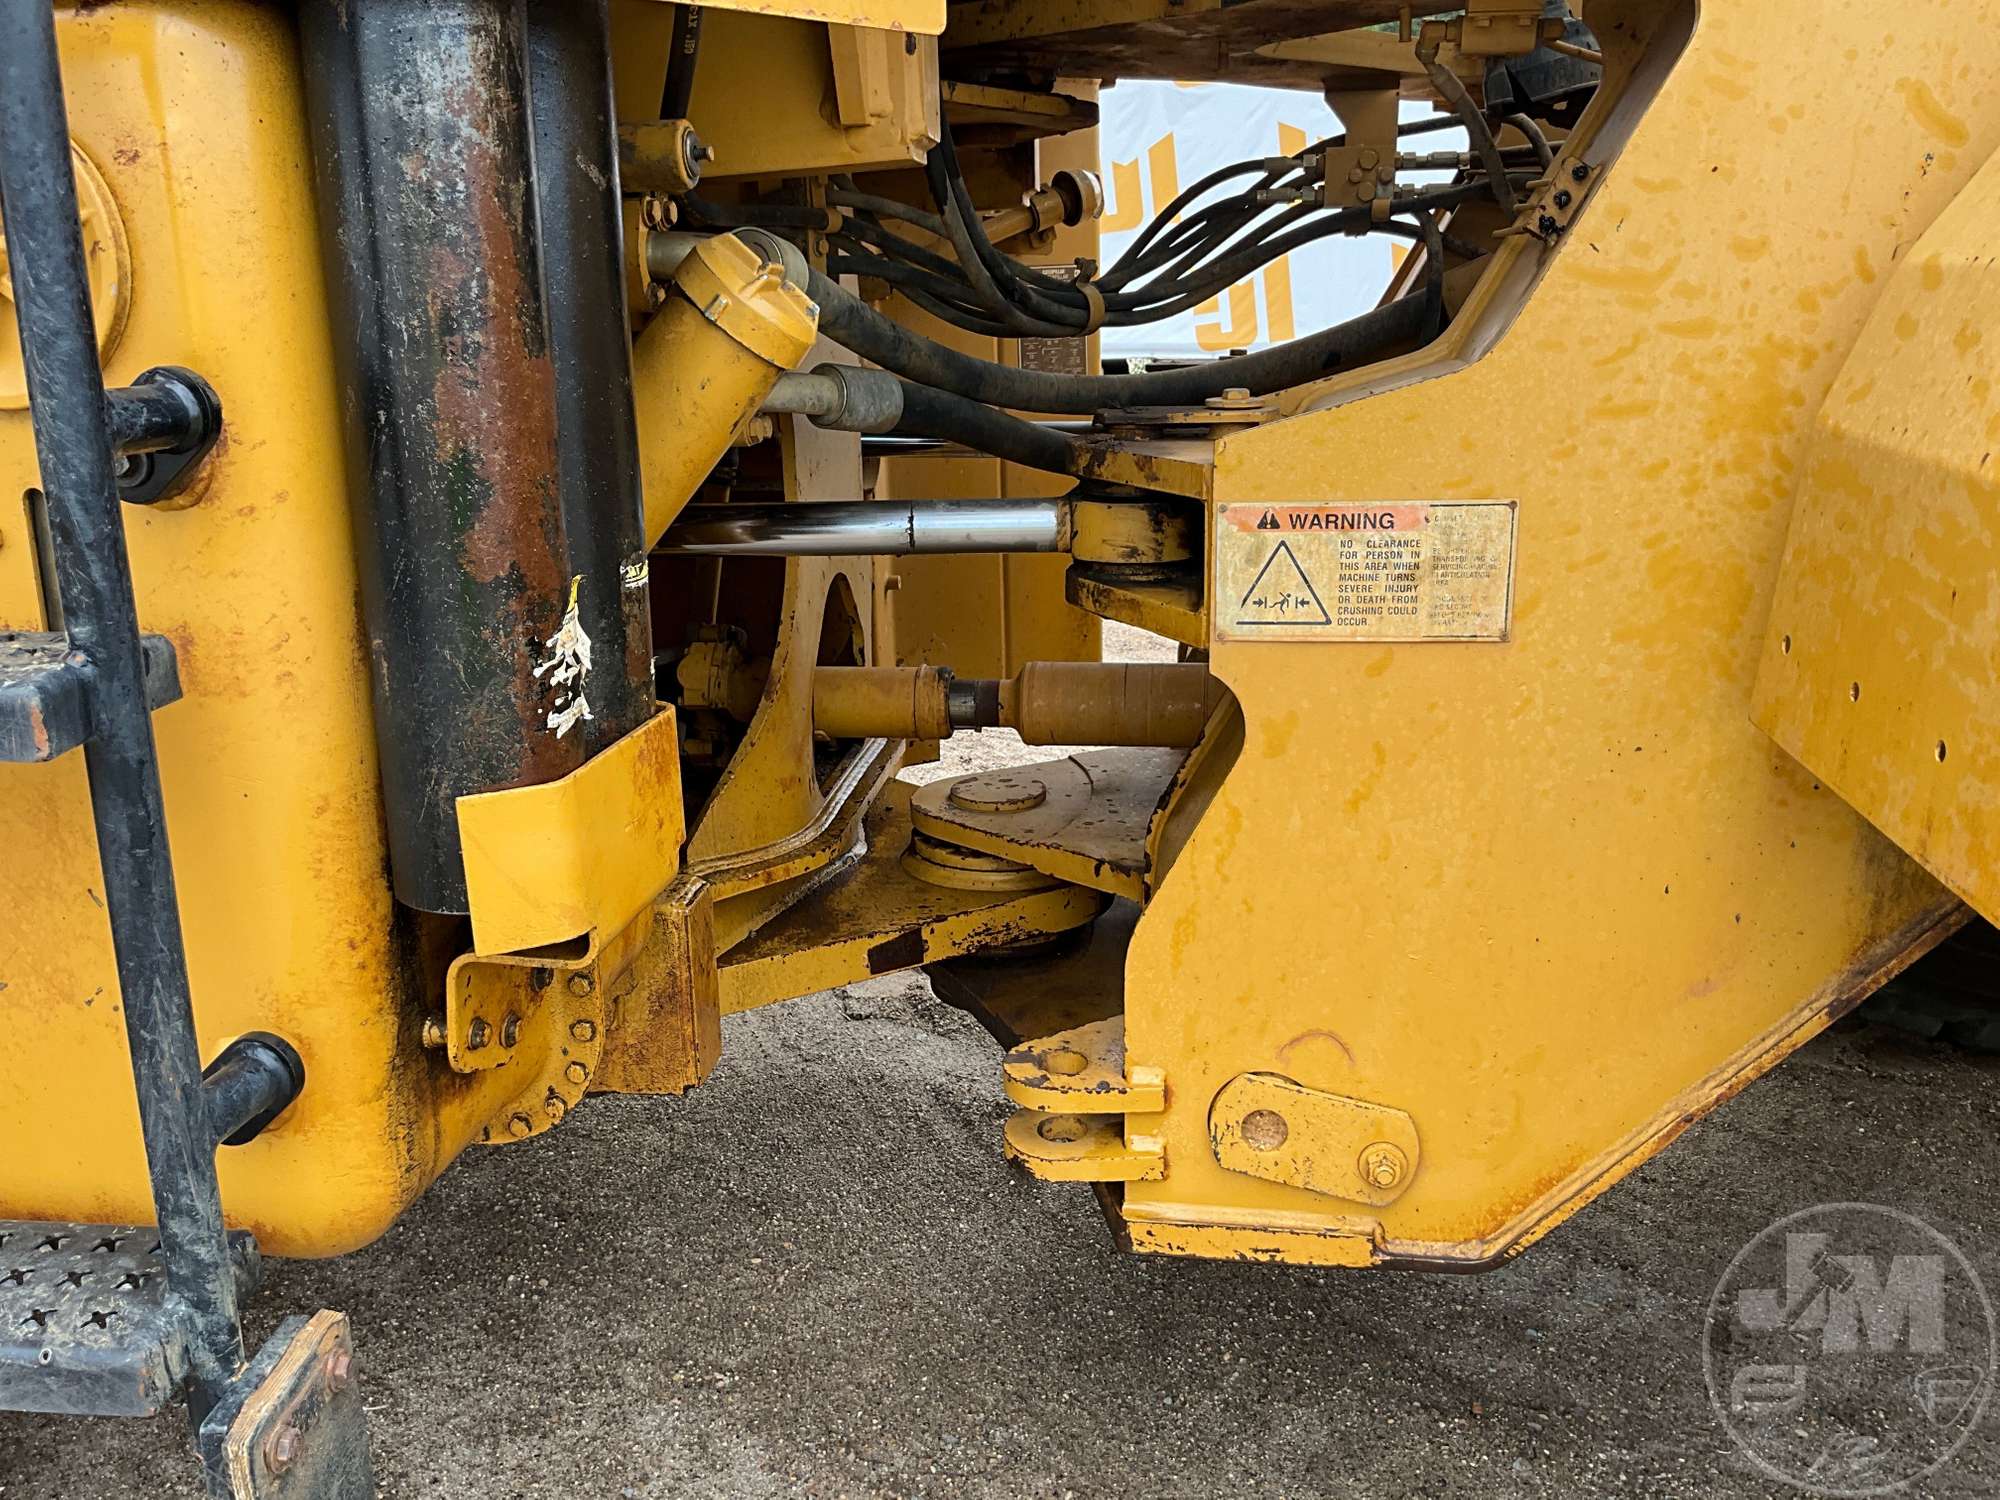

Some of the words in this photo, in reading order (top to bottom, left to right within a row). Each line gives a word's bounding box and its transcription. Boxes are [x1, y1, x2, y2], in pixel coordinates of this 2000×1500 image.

[1288, 512, 1394, 530] WARNING
[1340, 540, 1353, 548] NO
[1366, 539, 1421, 548] CLEARANCE
[1339, 551, 1358, 559] FOR
[1366, 551, 1402, 559] PERSON
[1411, 551, 1420, 559] IN
[1339, 562, 1359, 571] THIS
[1364, 562, 1388, 570] AREA
[1393, 562, 1420, 570] WHEN
[1338, 573, 1380, 582] MACHINE
[1338, 585, 1373, 593] SEVERE
[1384, 584, 1419, 593] INJURY
[1338, 596, 1351, 604] OR
[1357, 596, 1386, 604] DEATH
[1392, 596, 1418, 604] FROM
[1337, 607, 1383, 615] CRUSHING
[1387, 607, 1417, 615] COULD
